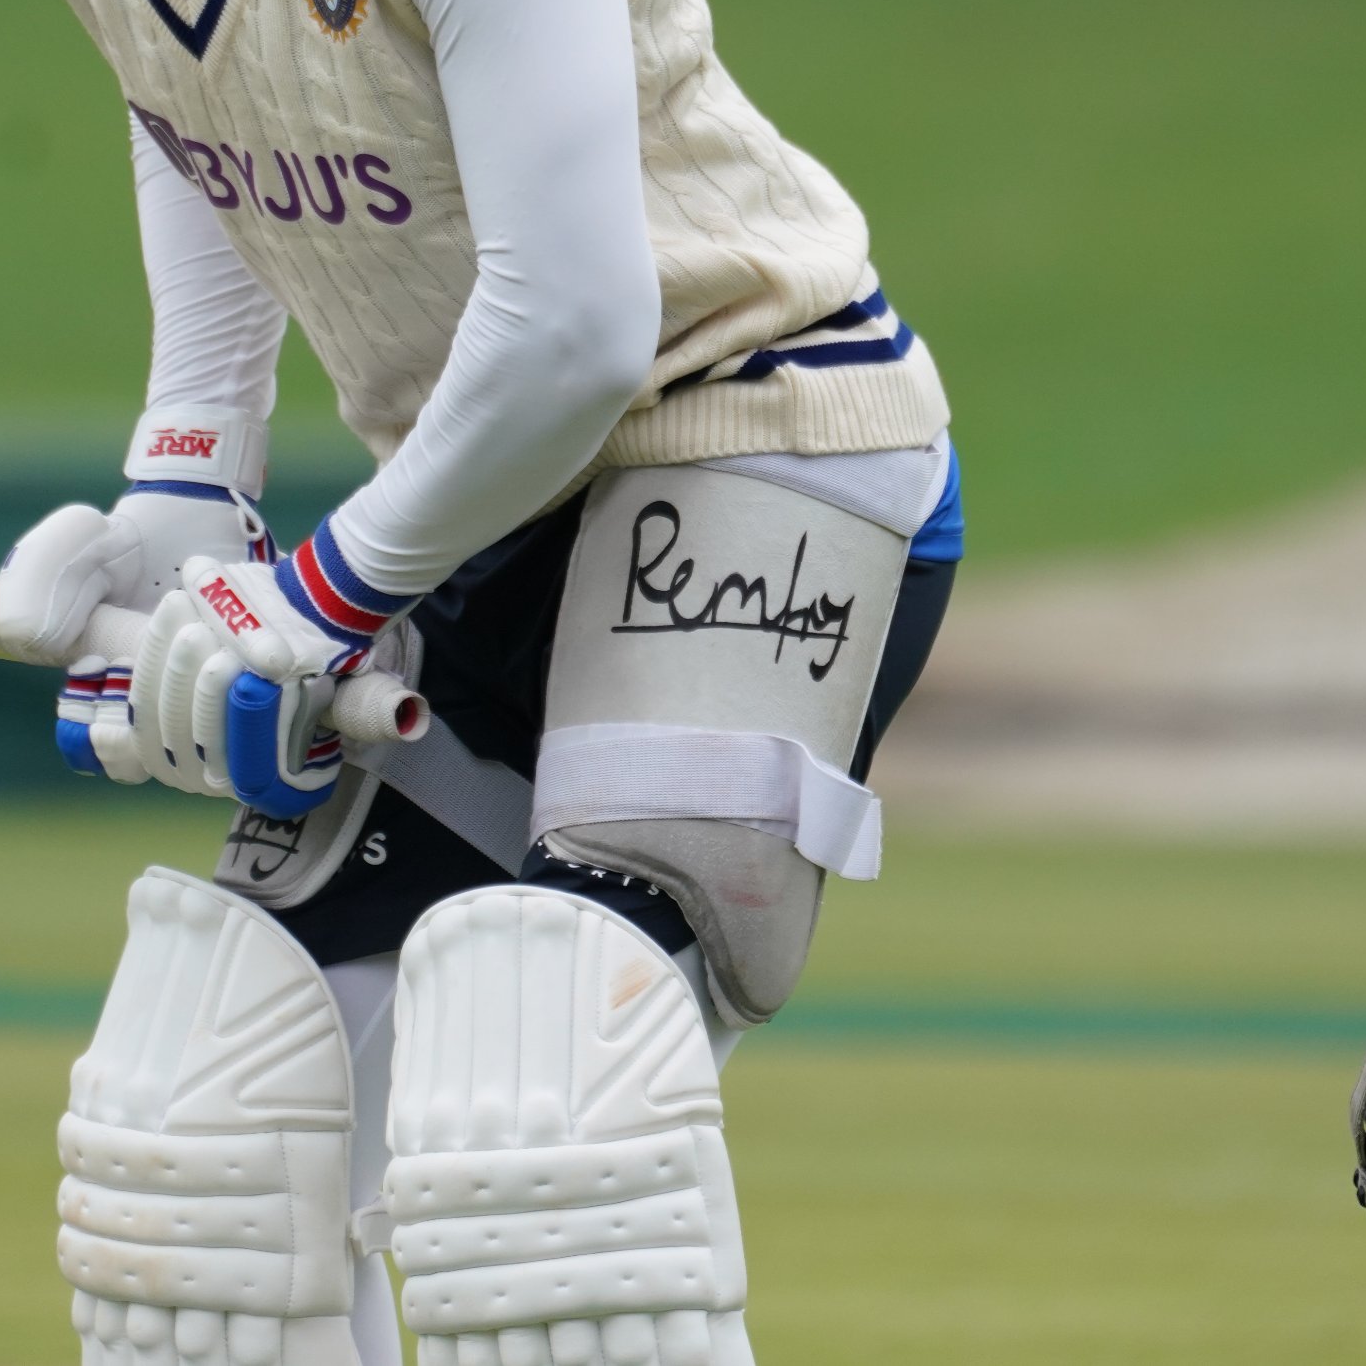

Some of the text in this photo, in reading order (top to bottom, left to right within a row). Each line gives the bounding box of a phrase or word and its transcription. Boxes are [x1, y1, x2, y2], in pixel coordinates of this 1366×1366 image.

[181, 137, 412, 225] BYJU'S
[147, 436, 218, 458] MRF
[199, 577, 262, 636] MRF
